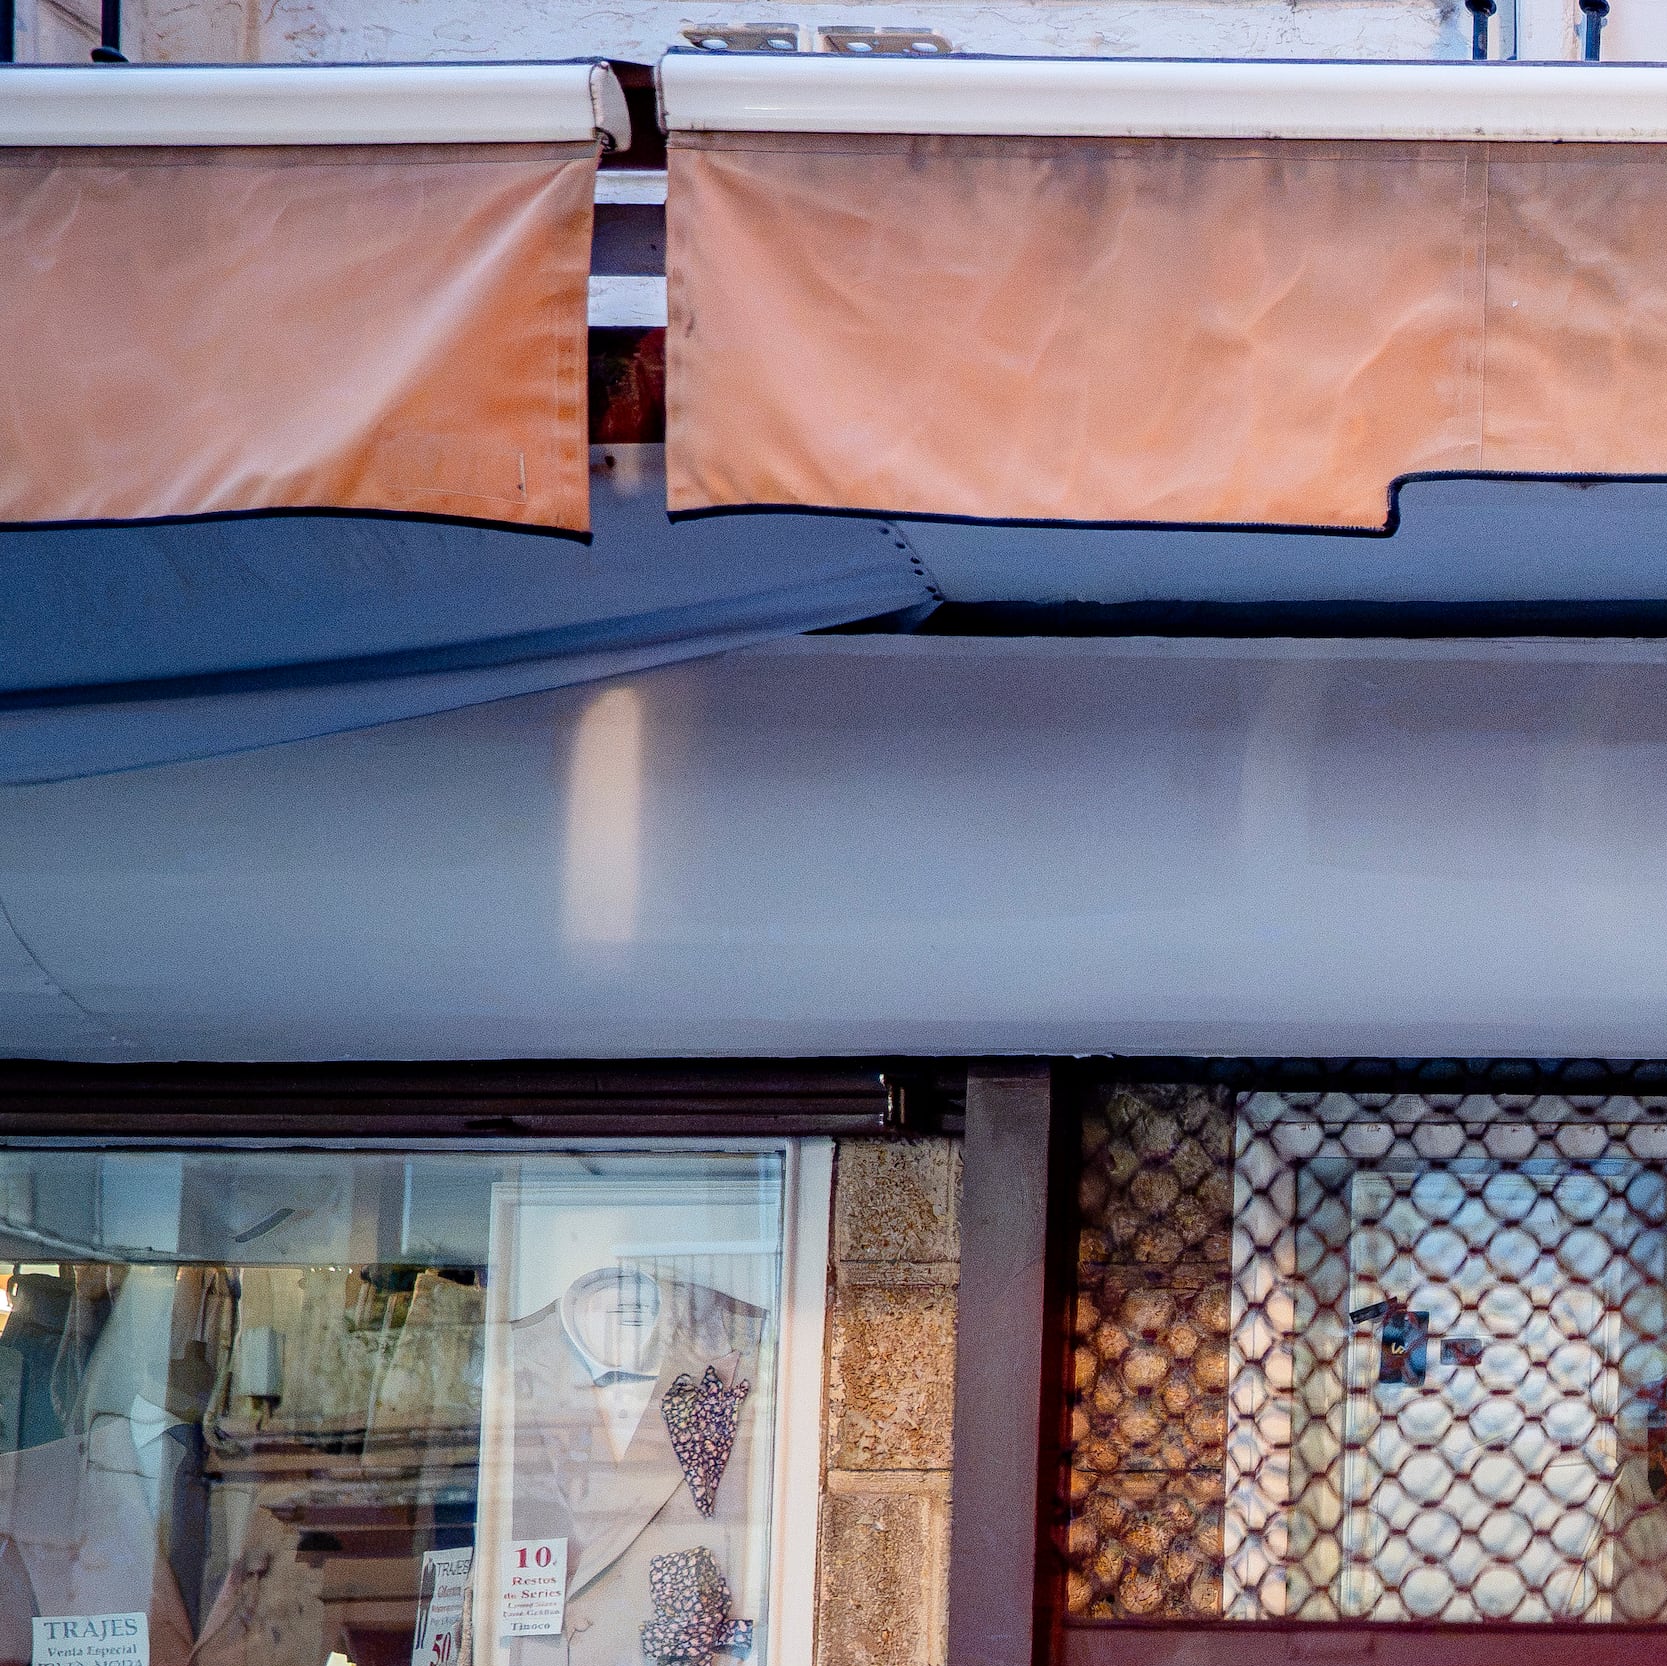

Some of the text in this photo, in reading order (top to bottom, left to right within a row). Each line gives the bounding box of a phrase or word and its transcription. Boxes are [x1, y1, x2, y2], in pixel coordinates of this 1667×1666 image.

[43, 1618, 139, 1642] TRAJES
[47, 1644, 138, 1657] Venta Especial
